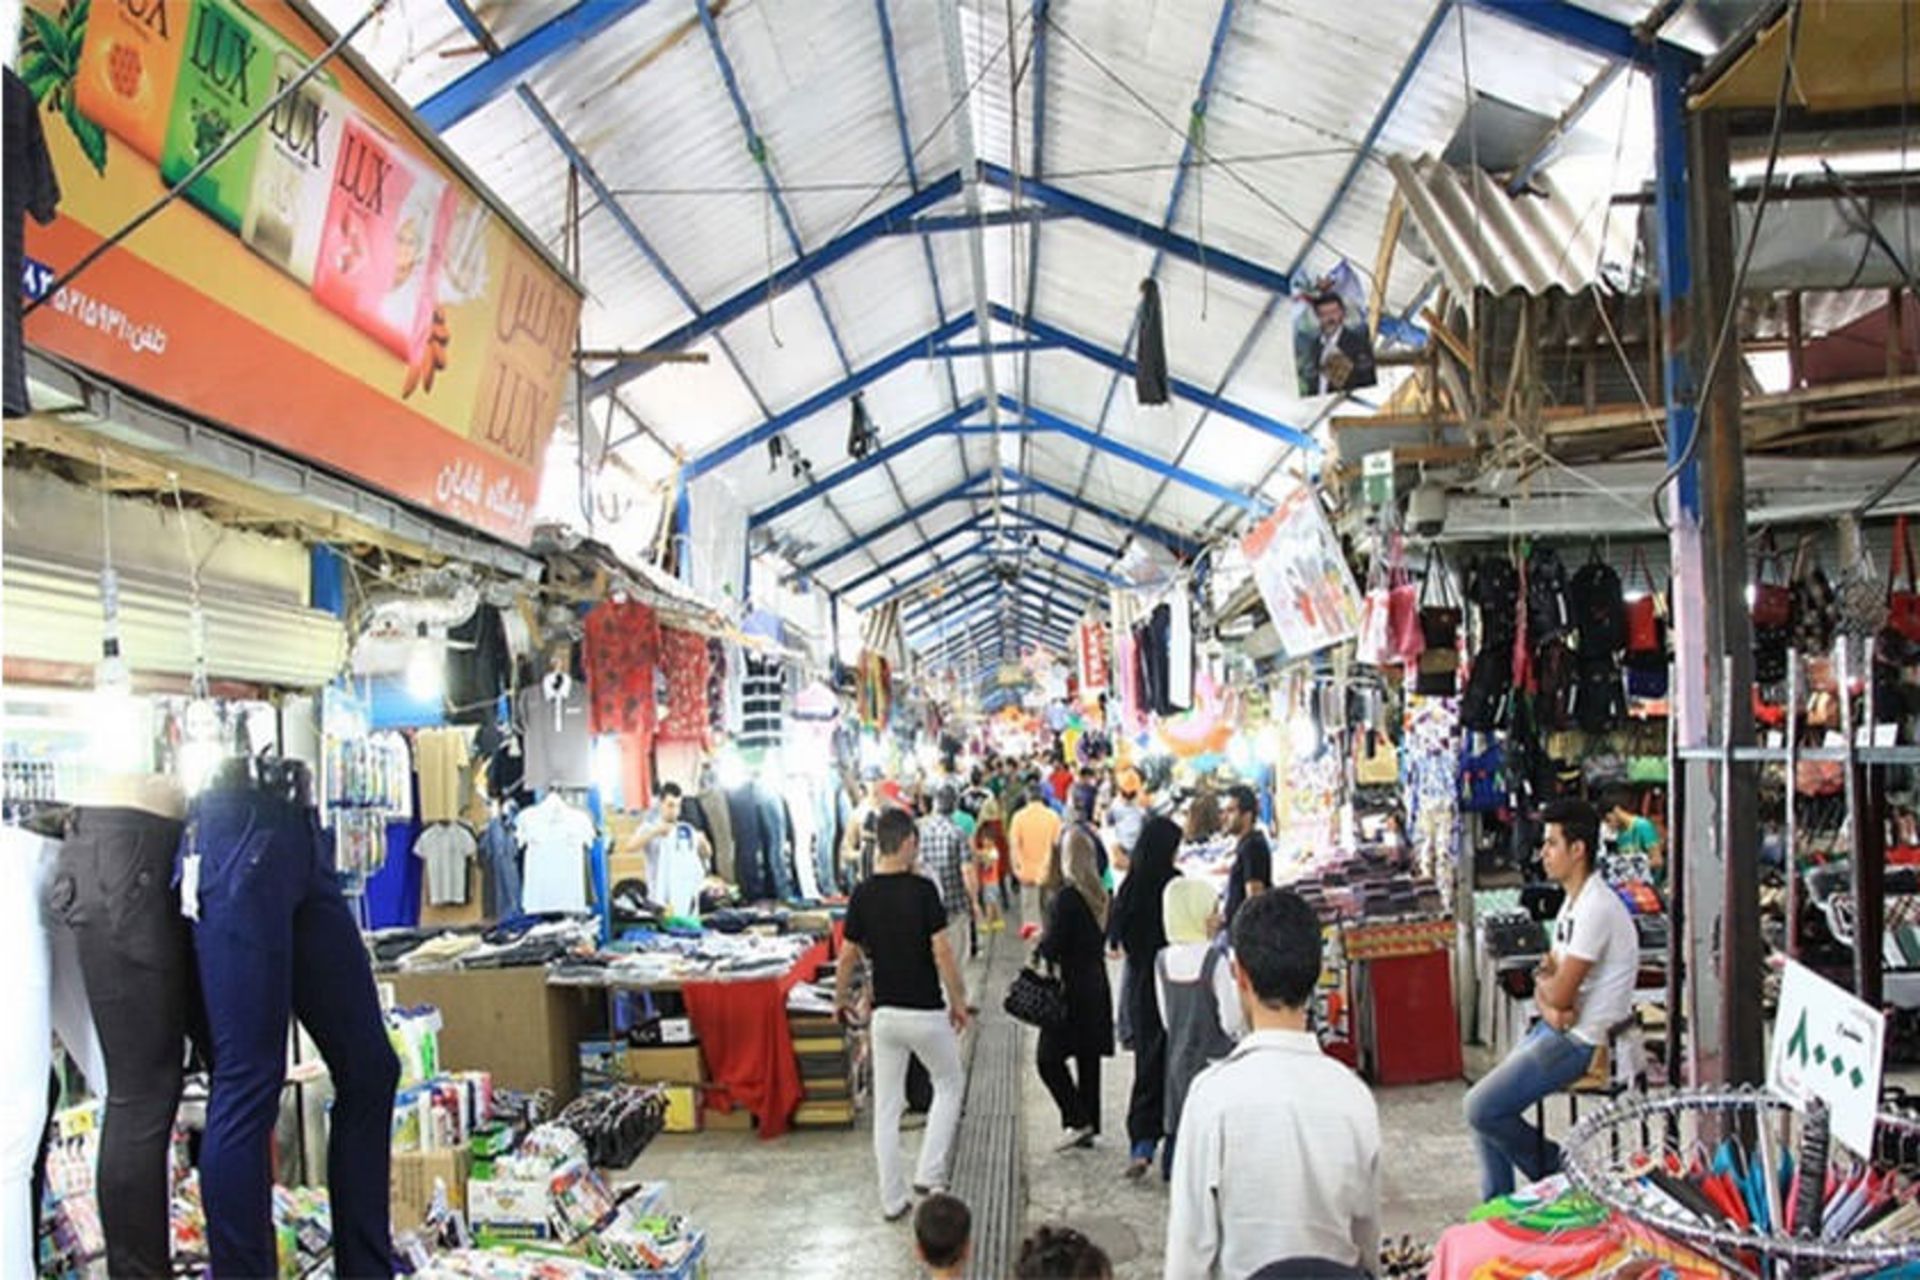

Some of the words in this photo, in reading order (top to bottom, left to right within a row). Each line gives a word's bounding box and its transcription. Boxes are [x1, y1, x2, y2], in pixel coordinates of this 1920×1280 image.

[190, 5, 258, 106] LUX
[269, 75, 329, 168] LUX
[339, 134, 393, 217] LUX
[486, 362, 549, 462] LUX
[1786, 1006, 1865, 1090] ۸۰۰۰
